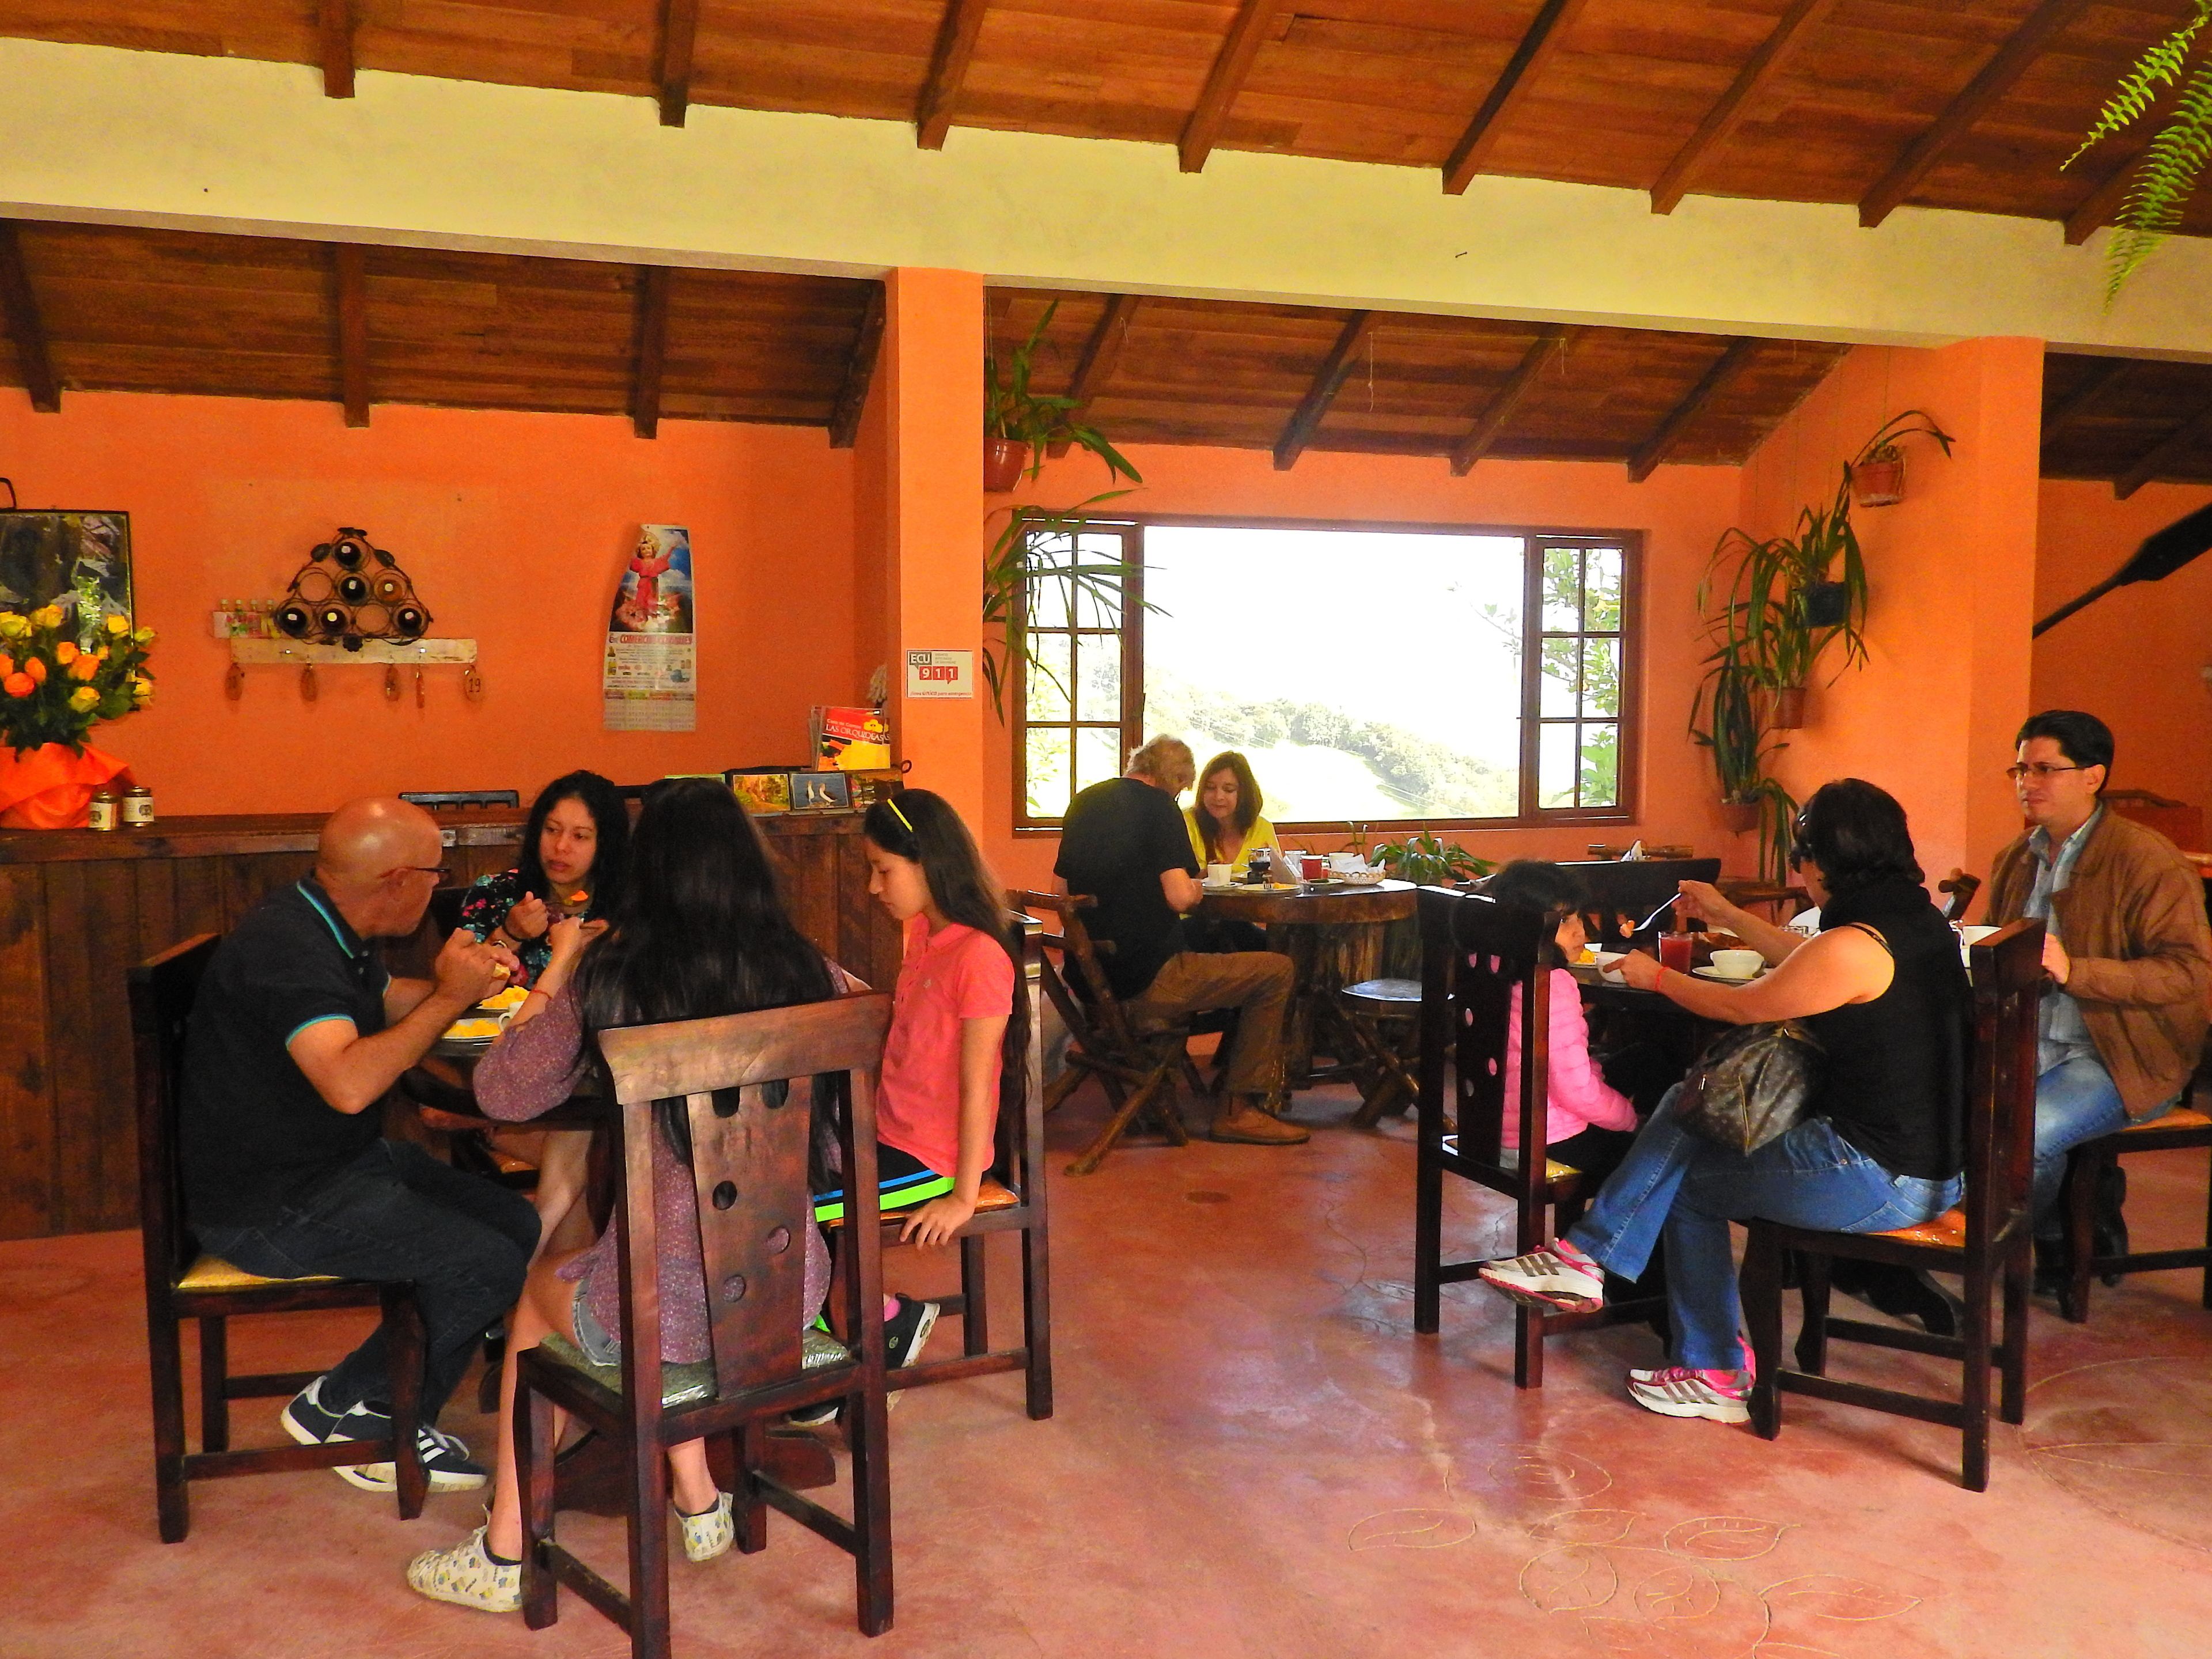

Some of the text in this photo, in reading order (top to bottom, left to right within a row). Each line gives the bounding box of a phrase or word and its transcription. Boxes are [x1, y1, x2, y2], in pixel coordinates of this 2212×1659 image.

[911, 654, 930, 664] ECU
[922, 668, 954, 679] 911
[469, 678, 480, 692] 19
[826, 724, 884, 741] LAS ORQUIDEAS
